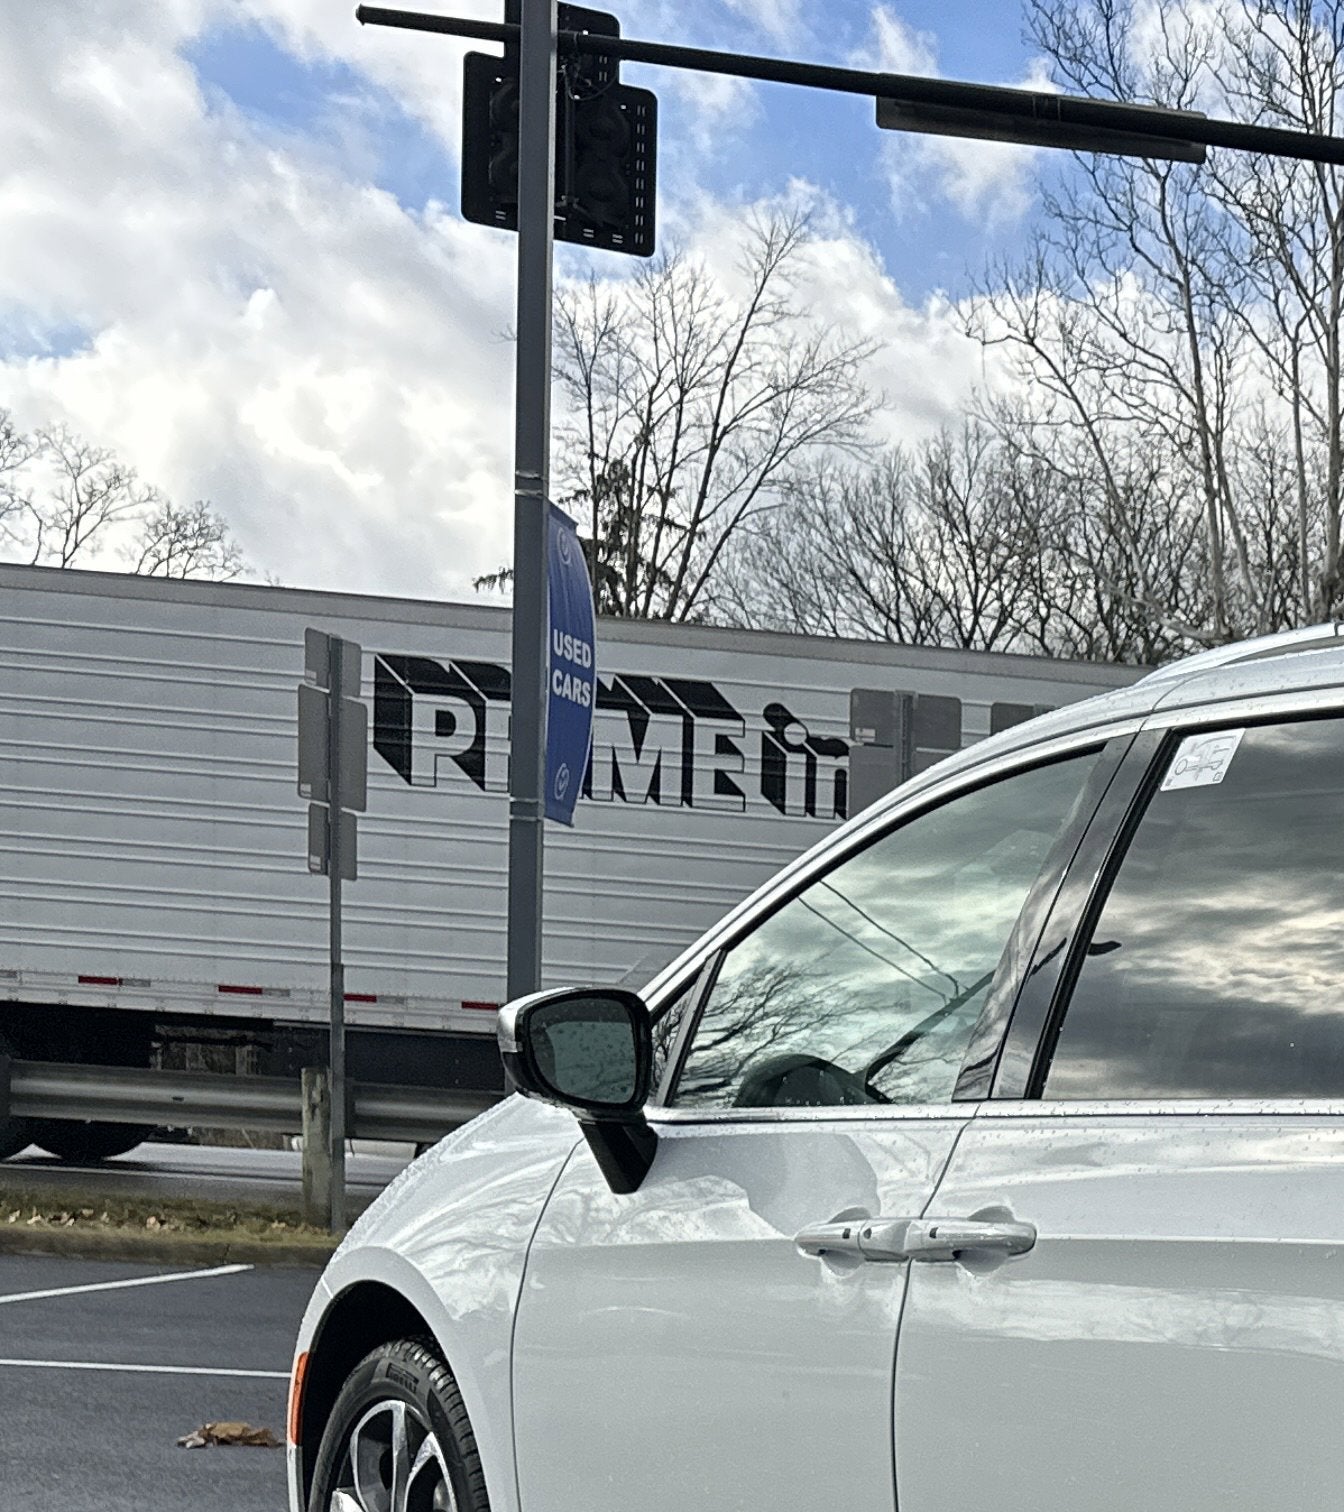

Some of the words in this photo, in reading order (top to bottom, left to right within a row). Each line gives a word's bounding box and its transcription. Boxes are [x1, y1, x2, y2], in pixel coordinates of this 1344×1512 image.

[553, 628, 593, 670] USED
[552, 668, 592, 708] CARS
[373, 653, 746, 813] PME
